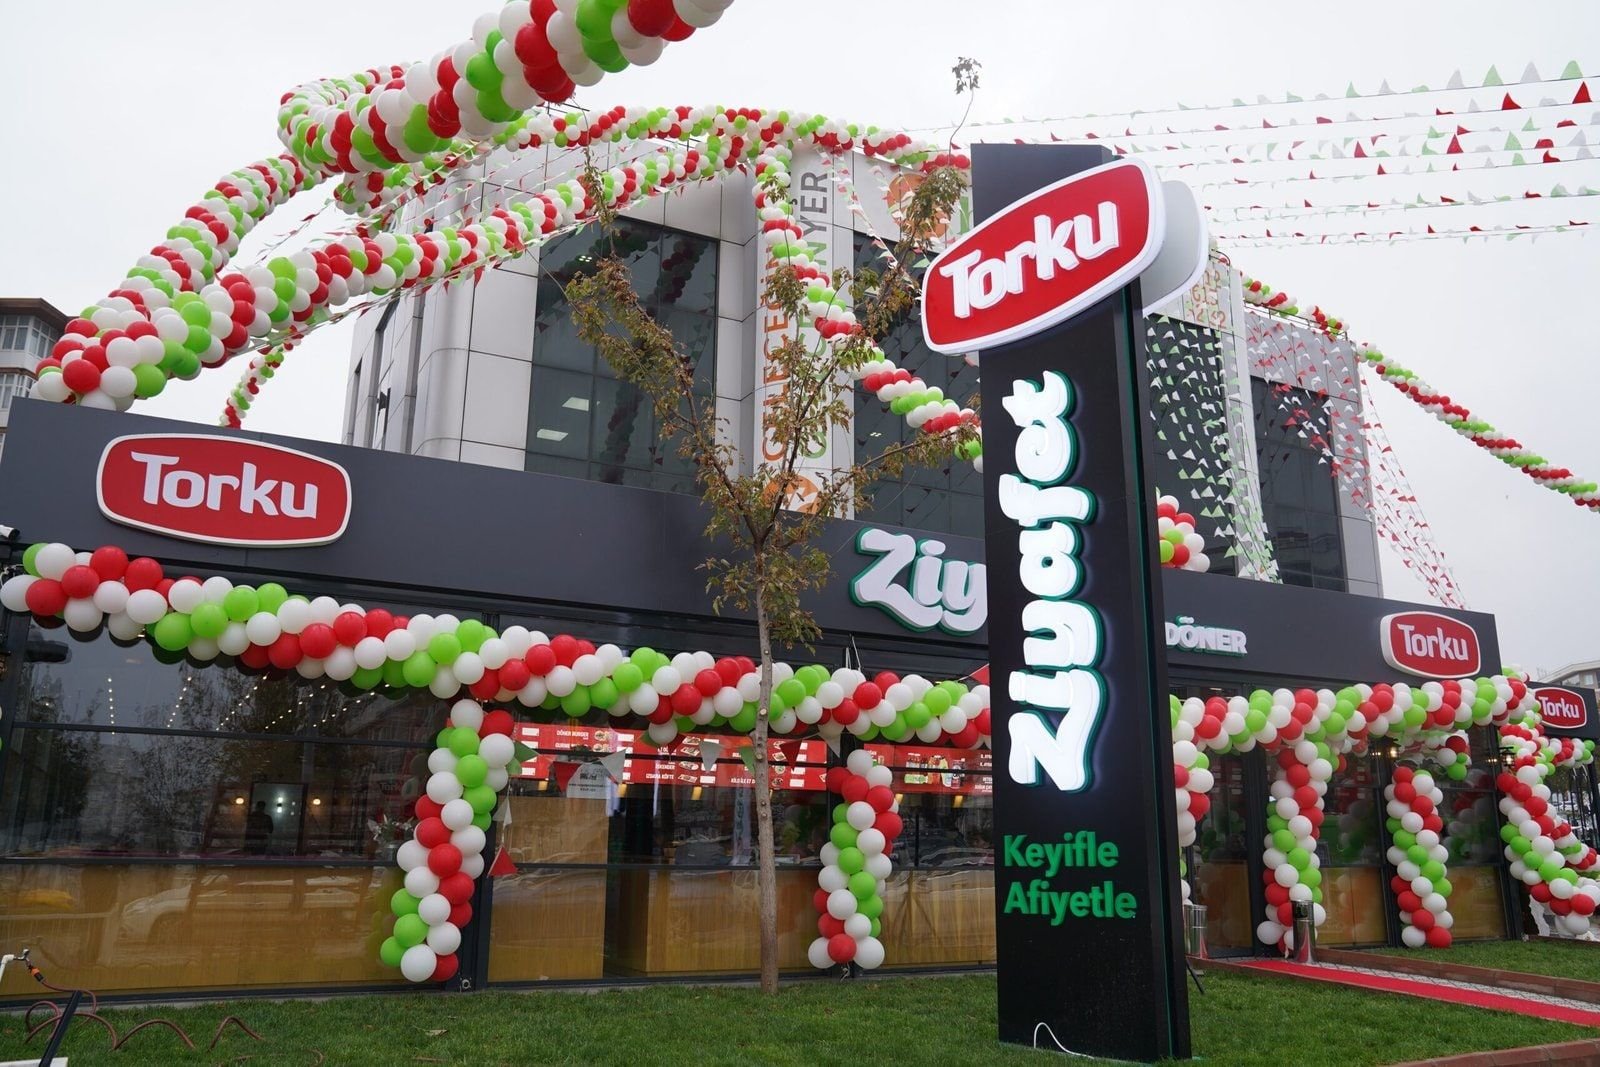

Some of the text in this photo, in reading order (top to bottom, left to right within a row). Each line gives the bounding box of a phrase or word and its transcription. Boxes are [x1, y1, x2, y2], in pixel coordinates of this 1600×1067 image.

[939, 201, 1120, 319] Torku
[131, 451, 318, 519] Torku
[999, 369, 1101, 792] Ziyafet
[1165, 615, 1247, 655] DÖNER
[1397, 623, 1469, 661] Torku
[1538, 696, 1579, 719] Torku
[1003, 830, 1119, 877] Keyifle
[1003, 879, 1137, 926] Afiyetle
